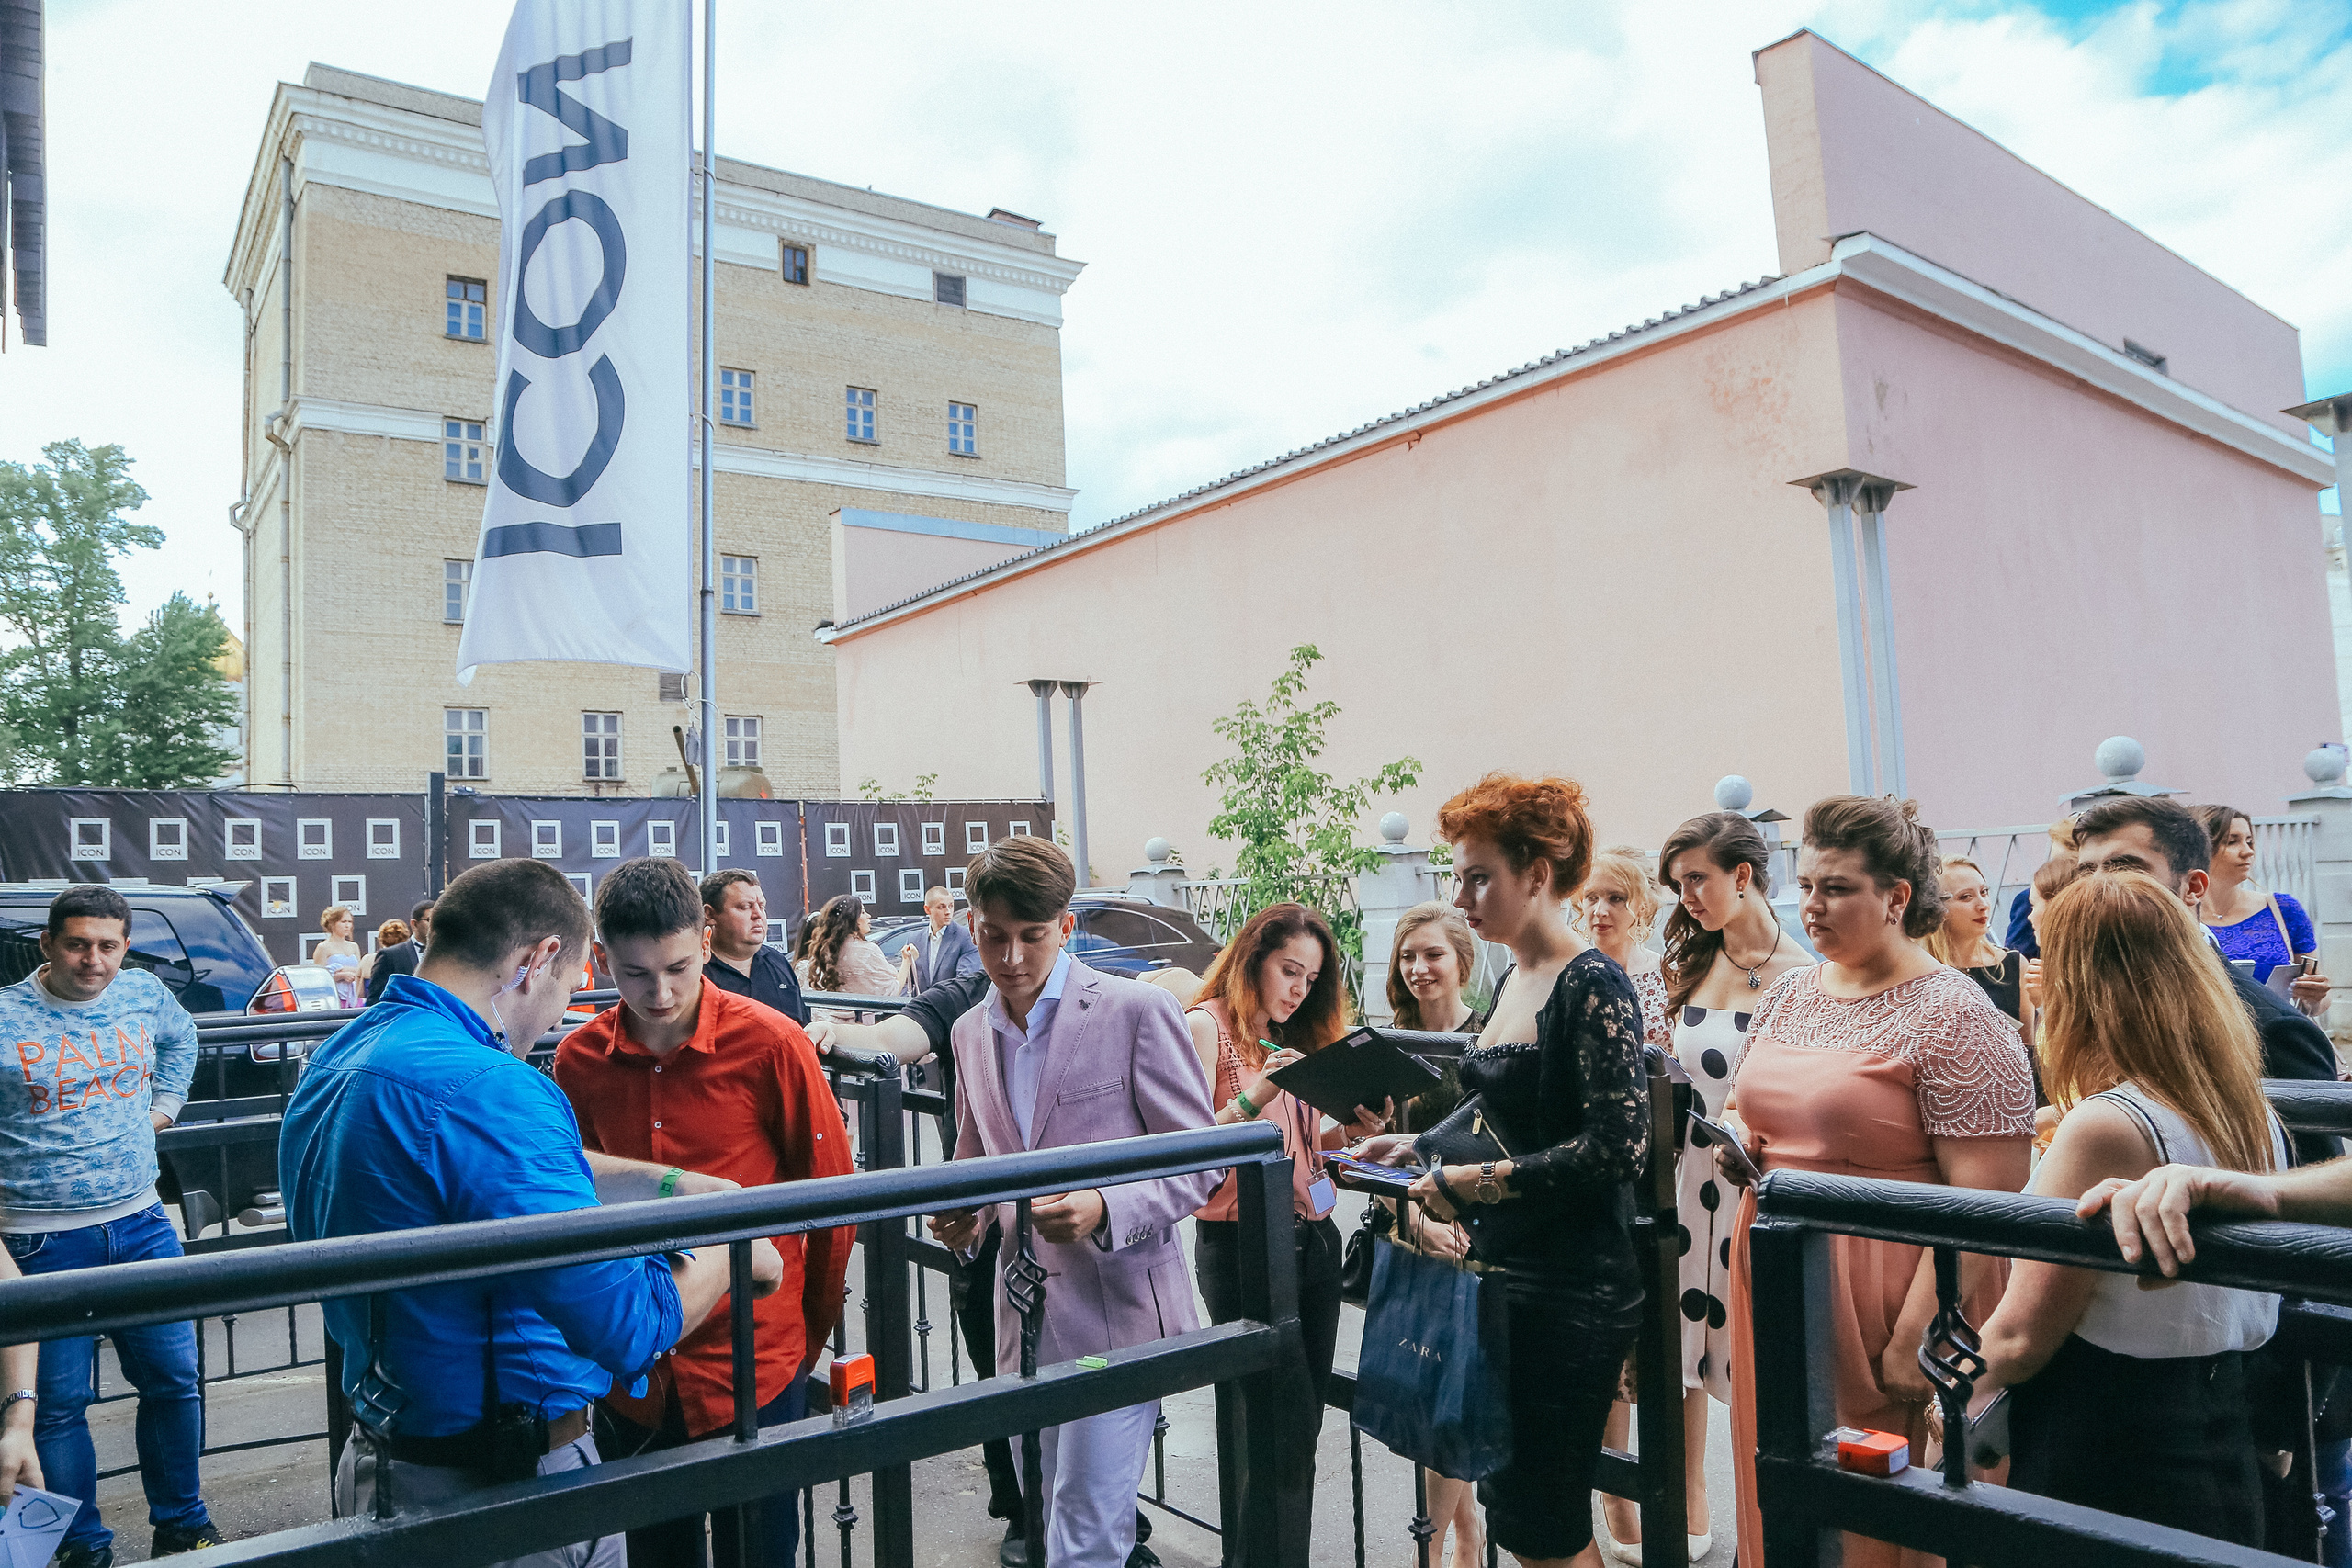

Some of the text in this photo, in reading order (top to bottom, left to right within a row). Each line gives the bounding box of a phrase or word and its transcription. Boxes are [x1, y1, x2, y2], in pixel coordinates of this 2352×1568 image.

[481, 36, 633, 559] ICON
[155, 848, 181, 856] ICON
[231, 848, 255, 856] ICON
[302, 848, 326, 856] ICON
[371, 847, 395, 855] ICON
[473, 847, 495, 855] ICON
[536, 847, 558, 855] ICON
[652, 846, 672, 854] ICON
[878, 846, 896, 854] ICON
[969, 844, 986, 852] ICON
[77, 849, 104, 857] ICON
[17, 1021, 155, 1082] PALM
[1398, 1337, 1442, 1362] ZARA
